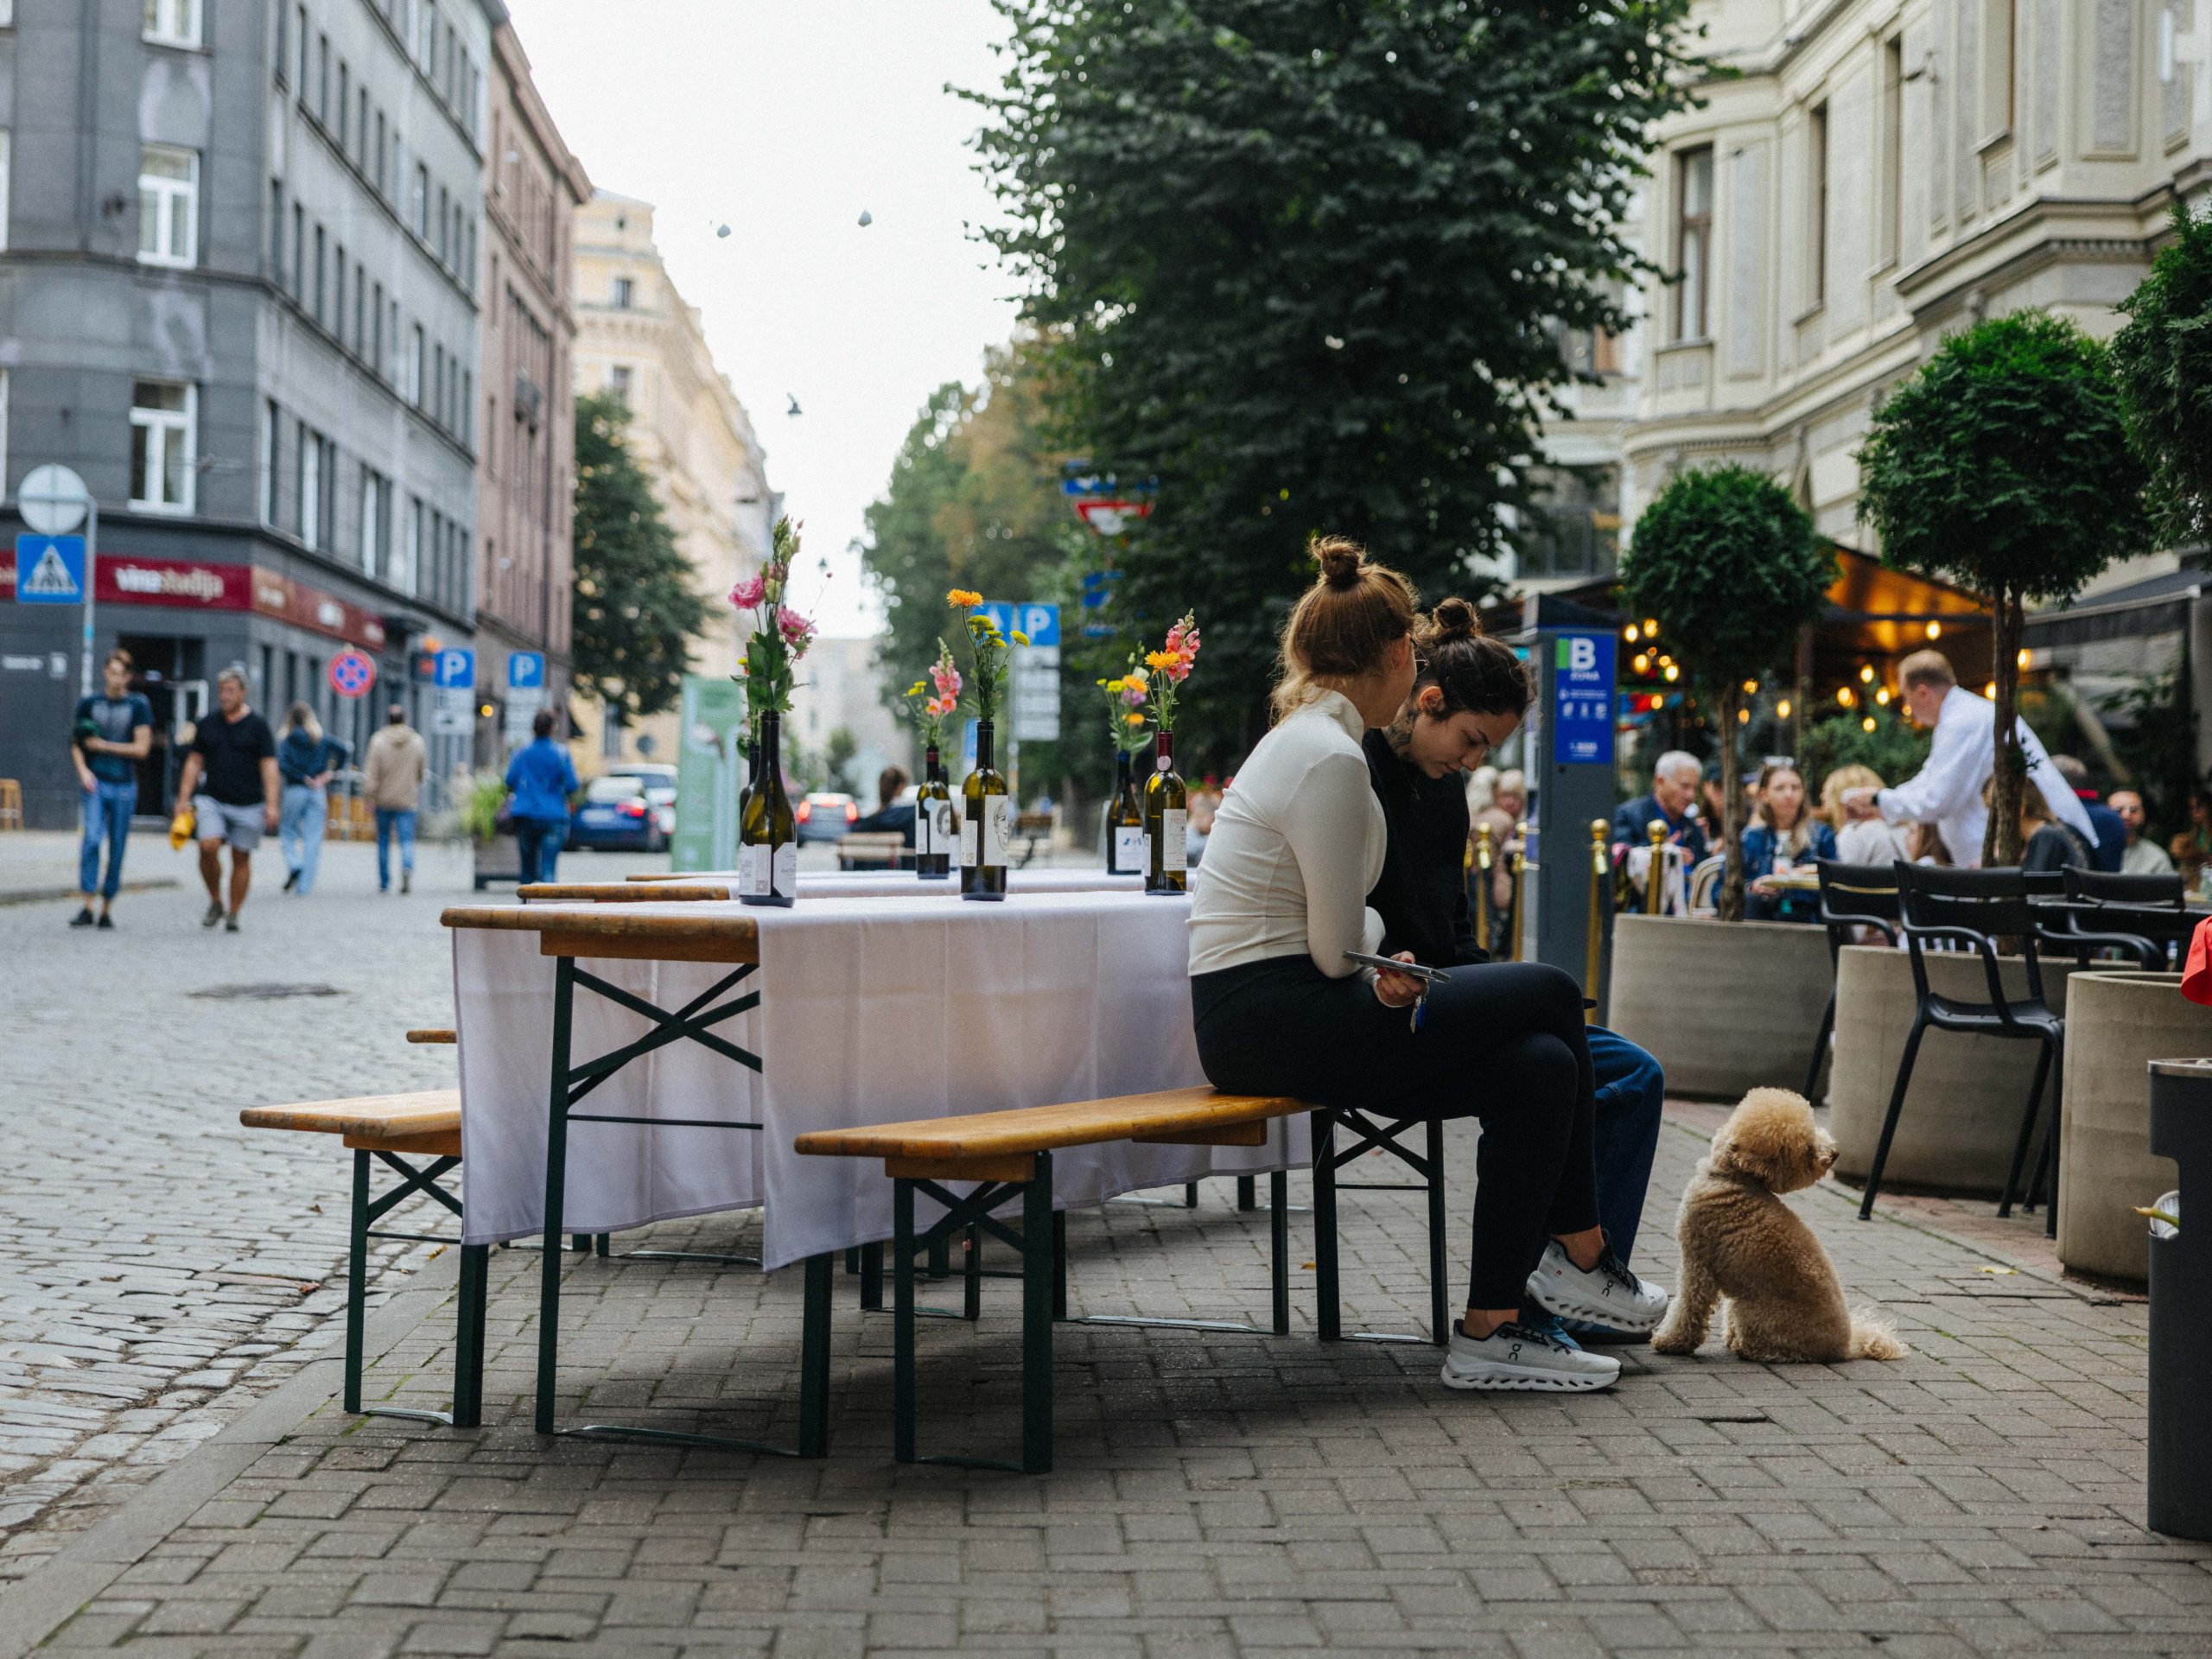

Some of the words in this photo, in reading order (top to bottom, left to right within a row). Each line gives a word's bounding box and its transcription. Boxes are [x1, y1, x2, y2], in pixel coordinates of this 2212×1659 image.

[1026, 607, 1051, 643] P
[442, 652, 467, 685] P
[514, 654, 536, 684] P
[1570, 638, 1596, 671] B
